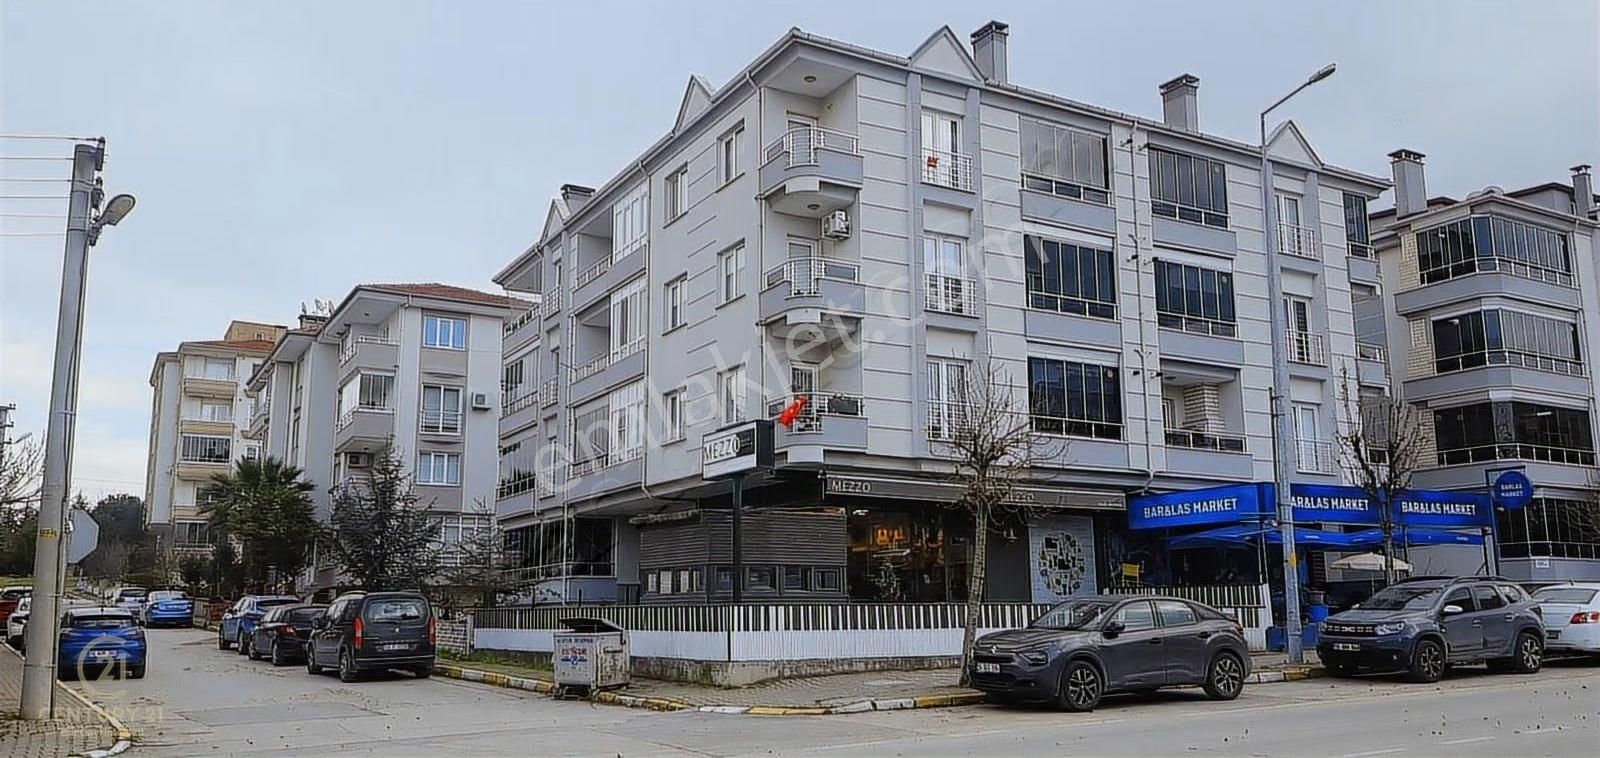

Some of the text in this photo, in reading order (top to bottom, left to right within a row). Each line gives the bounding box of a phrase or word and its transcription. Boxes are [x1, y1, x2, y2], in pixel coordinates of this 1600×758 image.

[704, 436, 741, 461] MEZZO
[831, 480, 871, 493] MEZZO
[1144, 498, 1238, 518] BAR&LAS MARKET
[1290, 496, 1369, 511] AR&LAS MARKET
[1401, 501, 1476, 516] BAR&LAS MARKET
